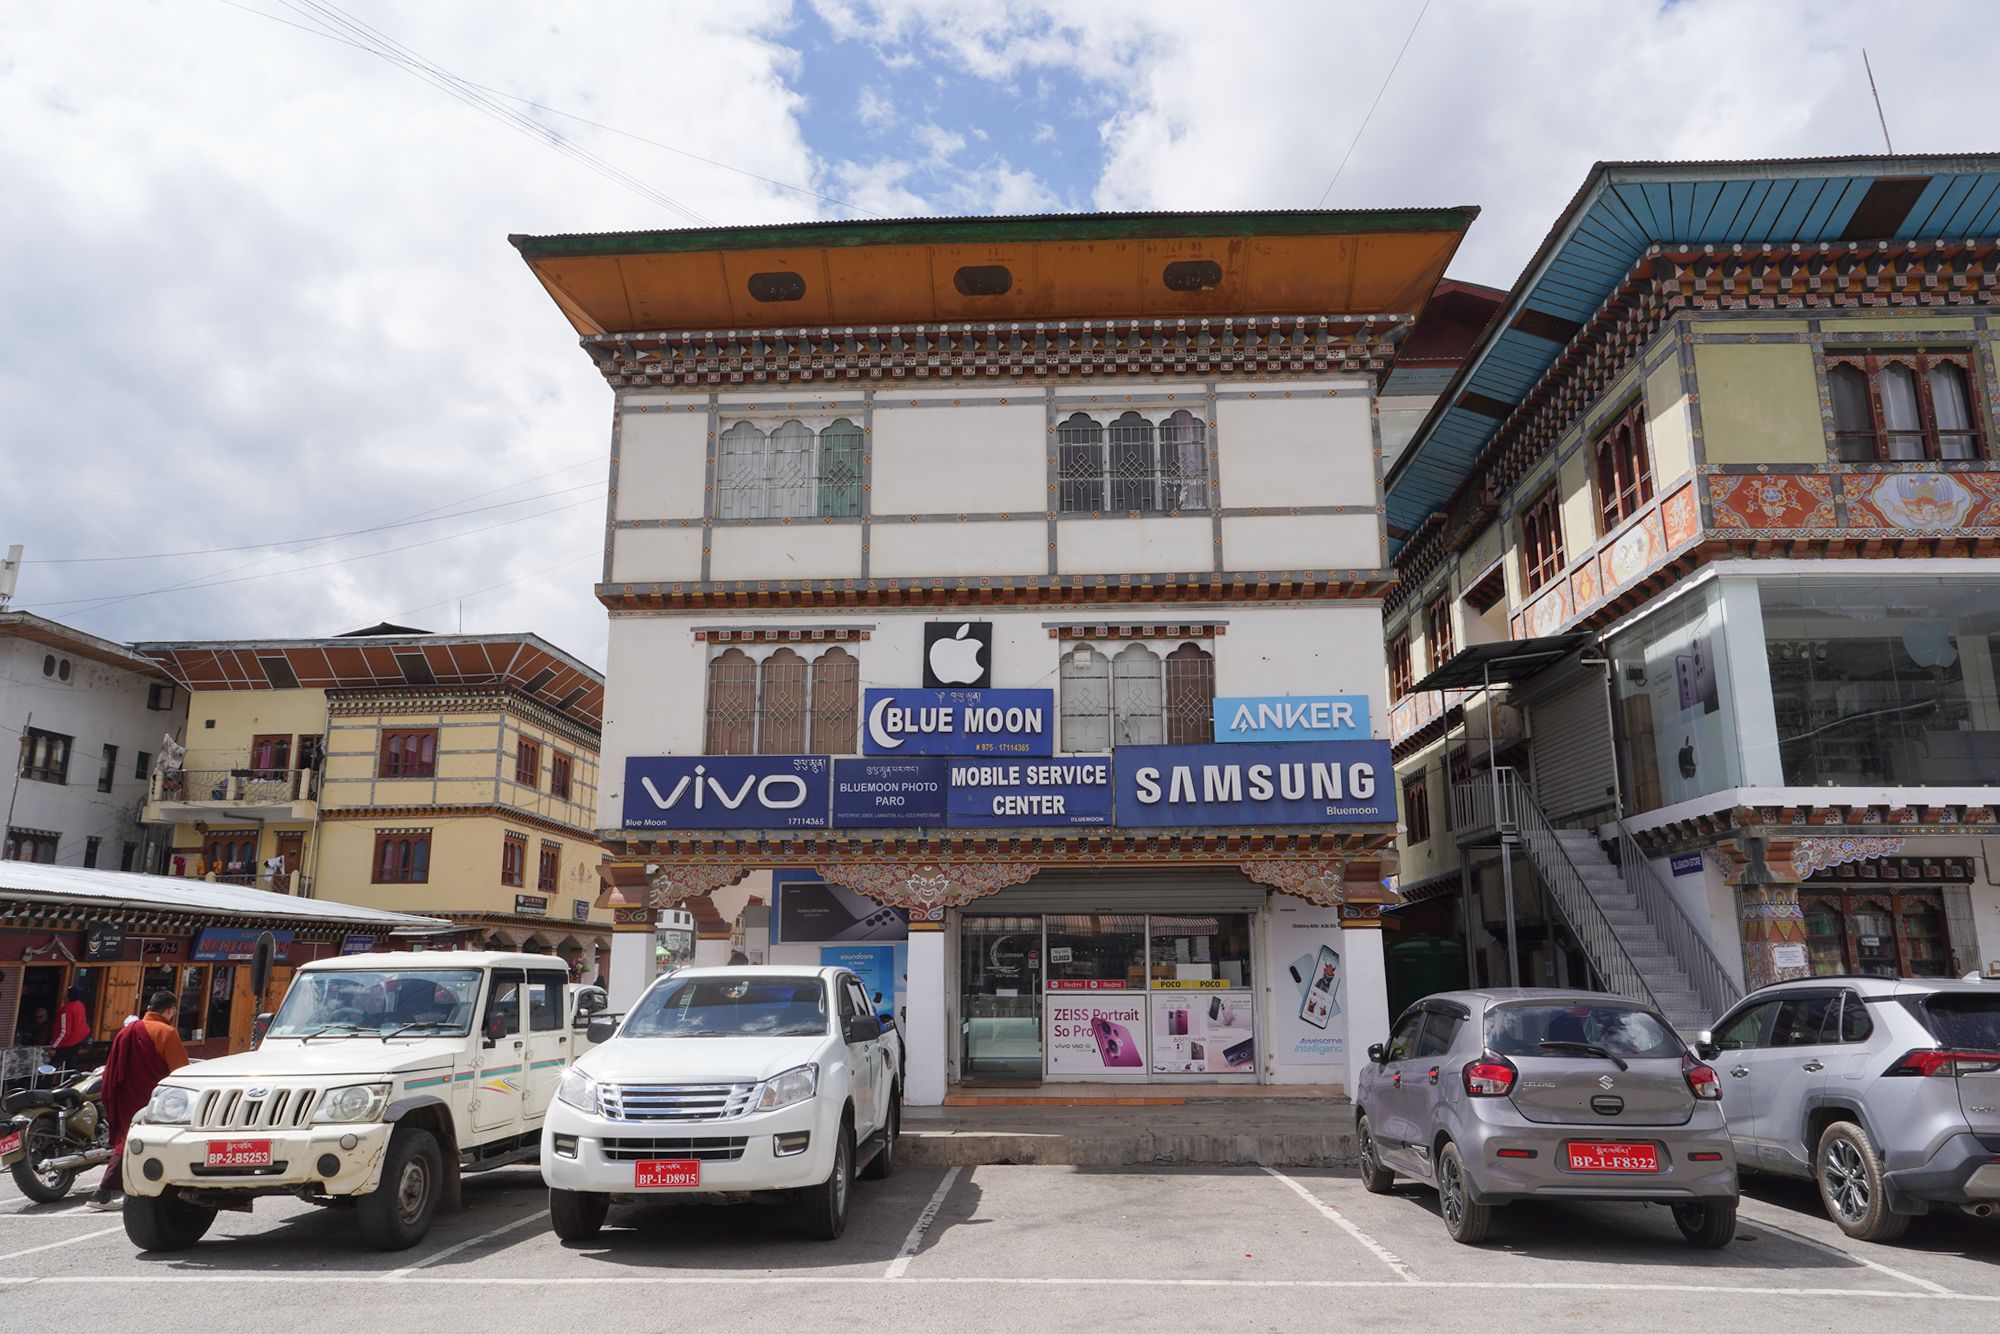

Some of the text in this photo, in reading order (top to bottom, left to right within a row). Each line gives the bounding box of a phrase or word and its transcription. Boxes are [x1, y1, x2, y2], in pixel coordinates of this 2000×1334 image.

[887, 707, 1042, 733] BLUE MOON
[1230, 702, 1356, 732] ANKER
[951, 765, 1107, 786] MOBILE SERVICE
[641, 764, 808, 810] vivo
[840, 782, 938, 792] BLUEMOON PHOTO
[1135, 762, 1375, 804] SAMSUNG
[875, 796, 905, 806] PARO
[992, 795, 1066, 815] CENTER
[1326, 806, 1378, 816] Bluemoon
[625, 818, 667, 827] Blue Moon
[787, 818, 824, 826] 17114365
[1054, 1008, 1139, 1021] ZEISS Portrait
[1054, 1025, 1094, 1037] So Pro
[209, 1152, 268, 1164] BP-2-B5253
[1572, 1156, 1655, 1168] BP-1-F8322
[639, 1173, 696, 1185] BP-1-D8915
